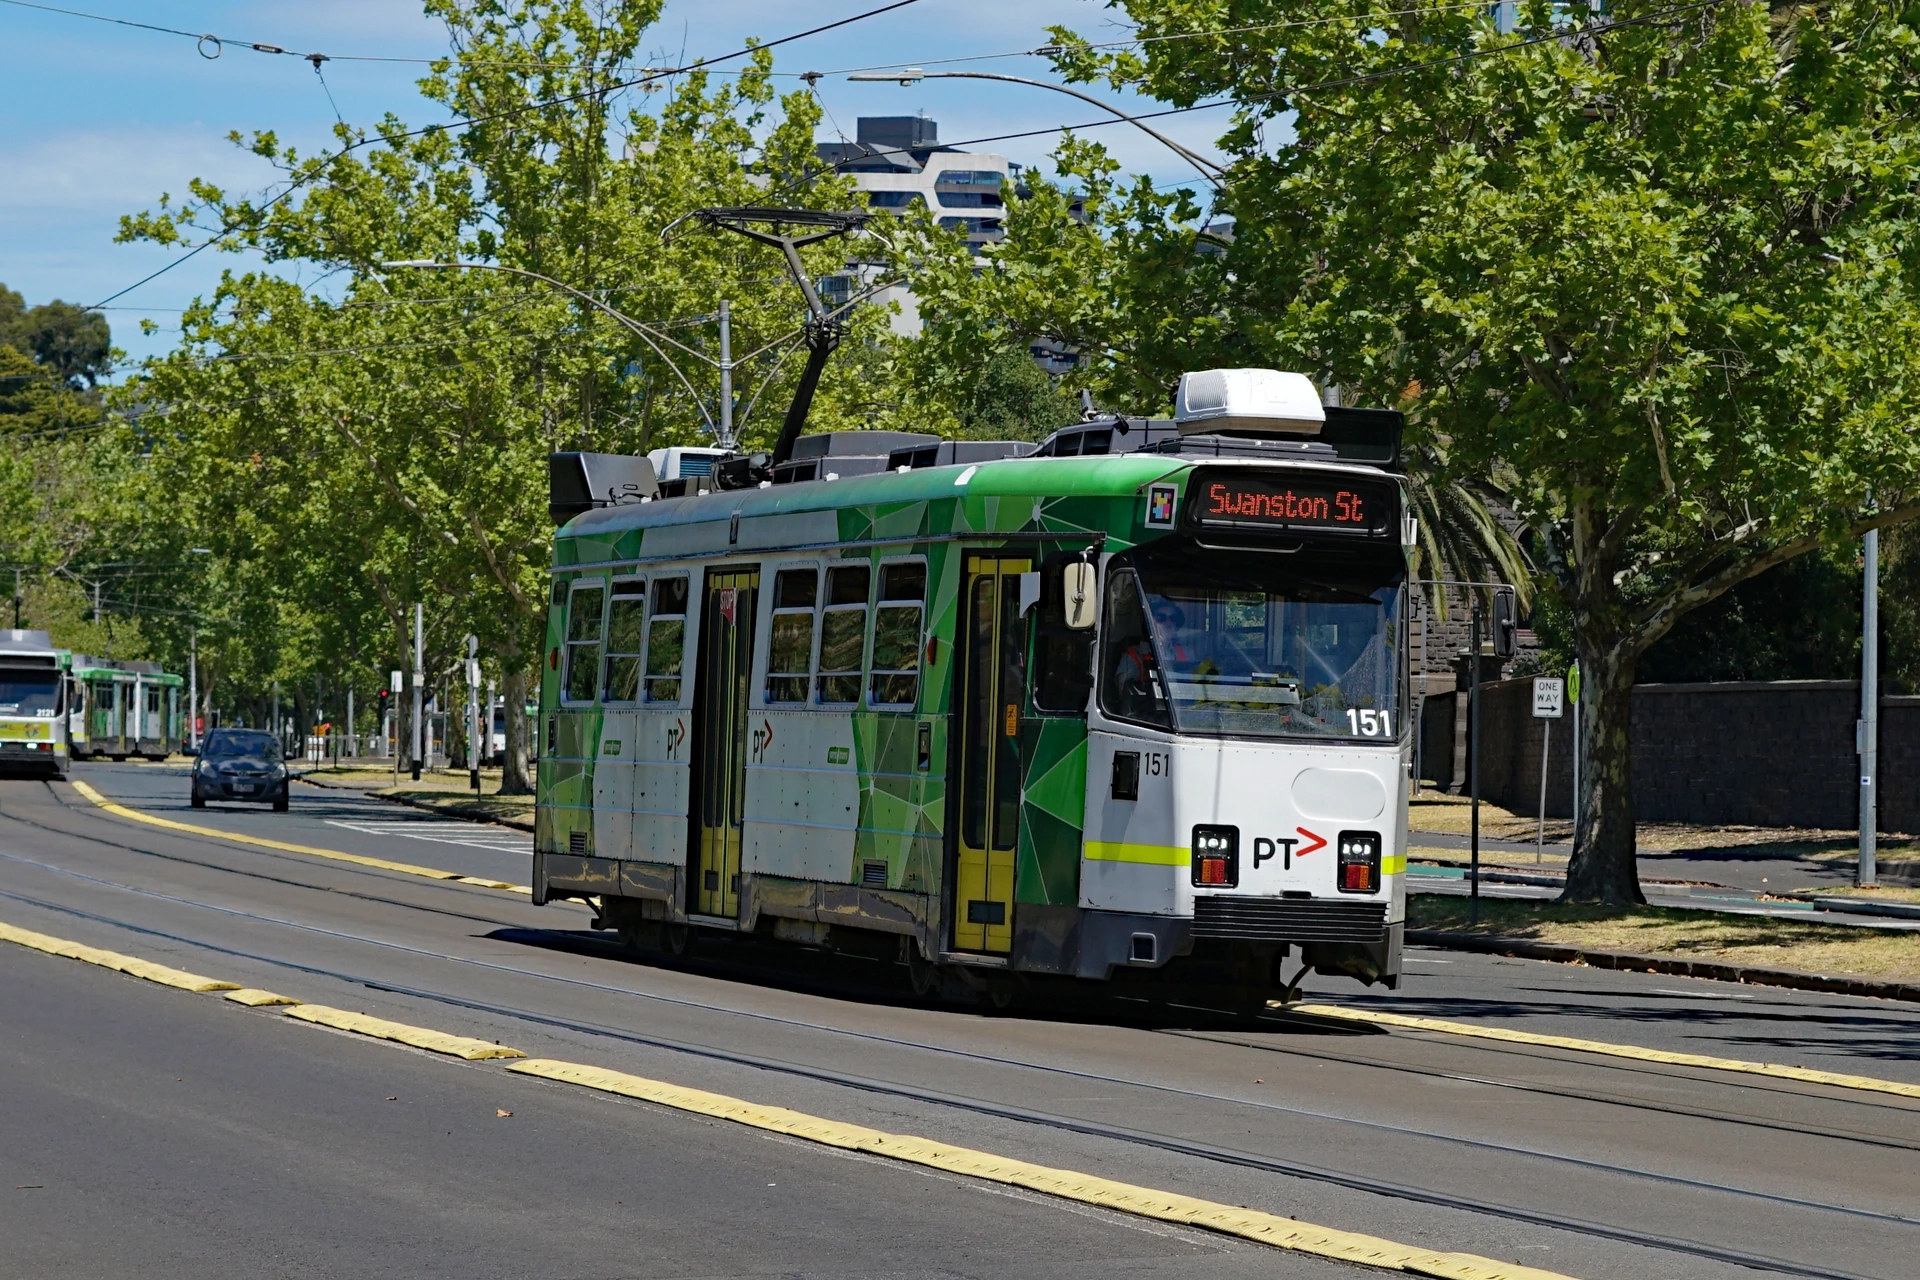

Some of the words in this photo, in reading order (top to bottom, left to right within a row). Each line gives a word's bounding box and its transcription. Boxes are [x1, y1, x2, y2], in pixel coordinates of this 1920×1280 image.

[1209, 483, 1329, 519] Swanston
[1335, 491, 1363, 522] St
[720, 590, 734, 610] STOP
[1538, 682, 1558, 691] ONE
[1537, 694, 1559, 702] WAY
[1346, 708, 1391, 737] 151
[1145, 752, 1170, 777] 151
